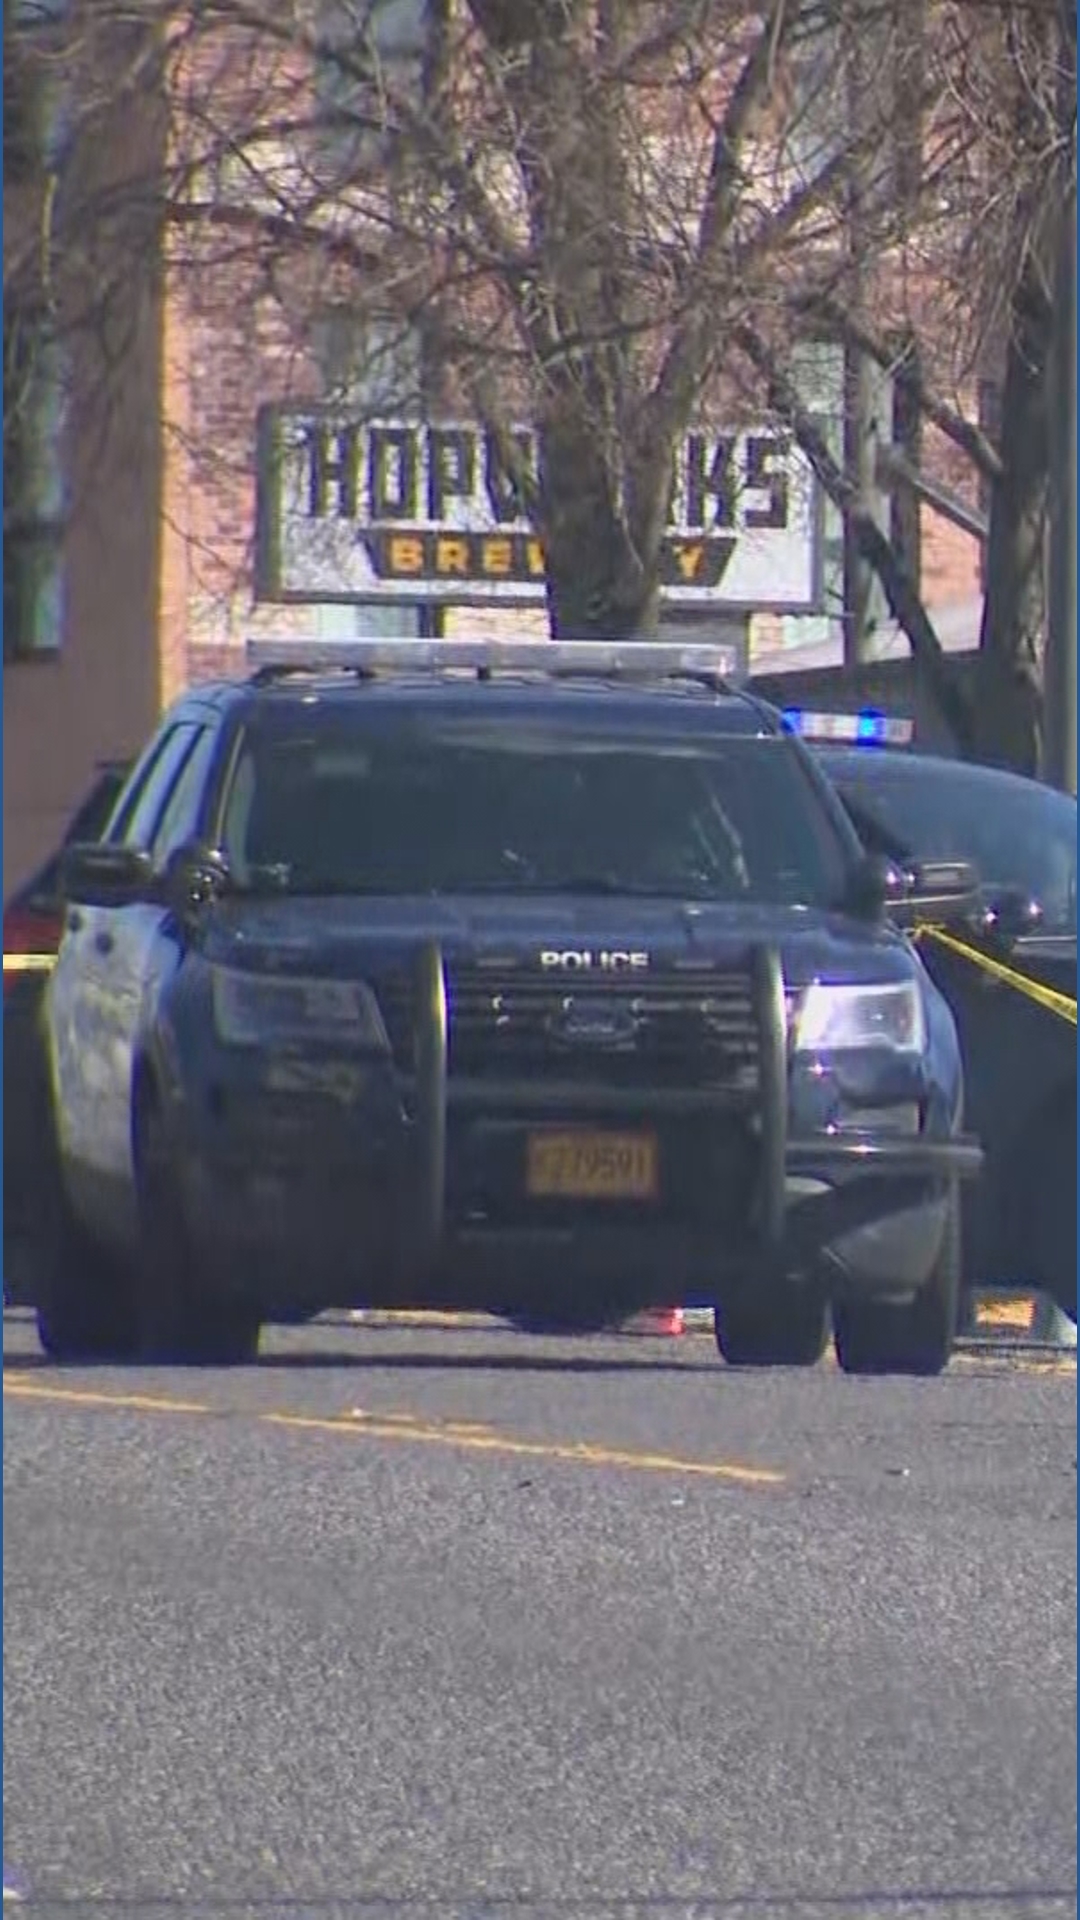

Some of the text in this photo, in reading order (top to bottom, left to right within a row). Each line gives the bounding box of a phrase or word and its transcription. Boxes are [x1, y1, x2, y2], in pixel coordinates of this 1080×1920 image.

[308, 426, 787, 527] HOPWKS
[390, 536, 704, 577] BREY
[541, 951, 648, 968] POLICE
